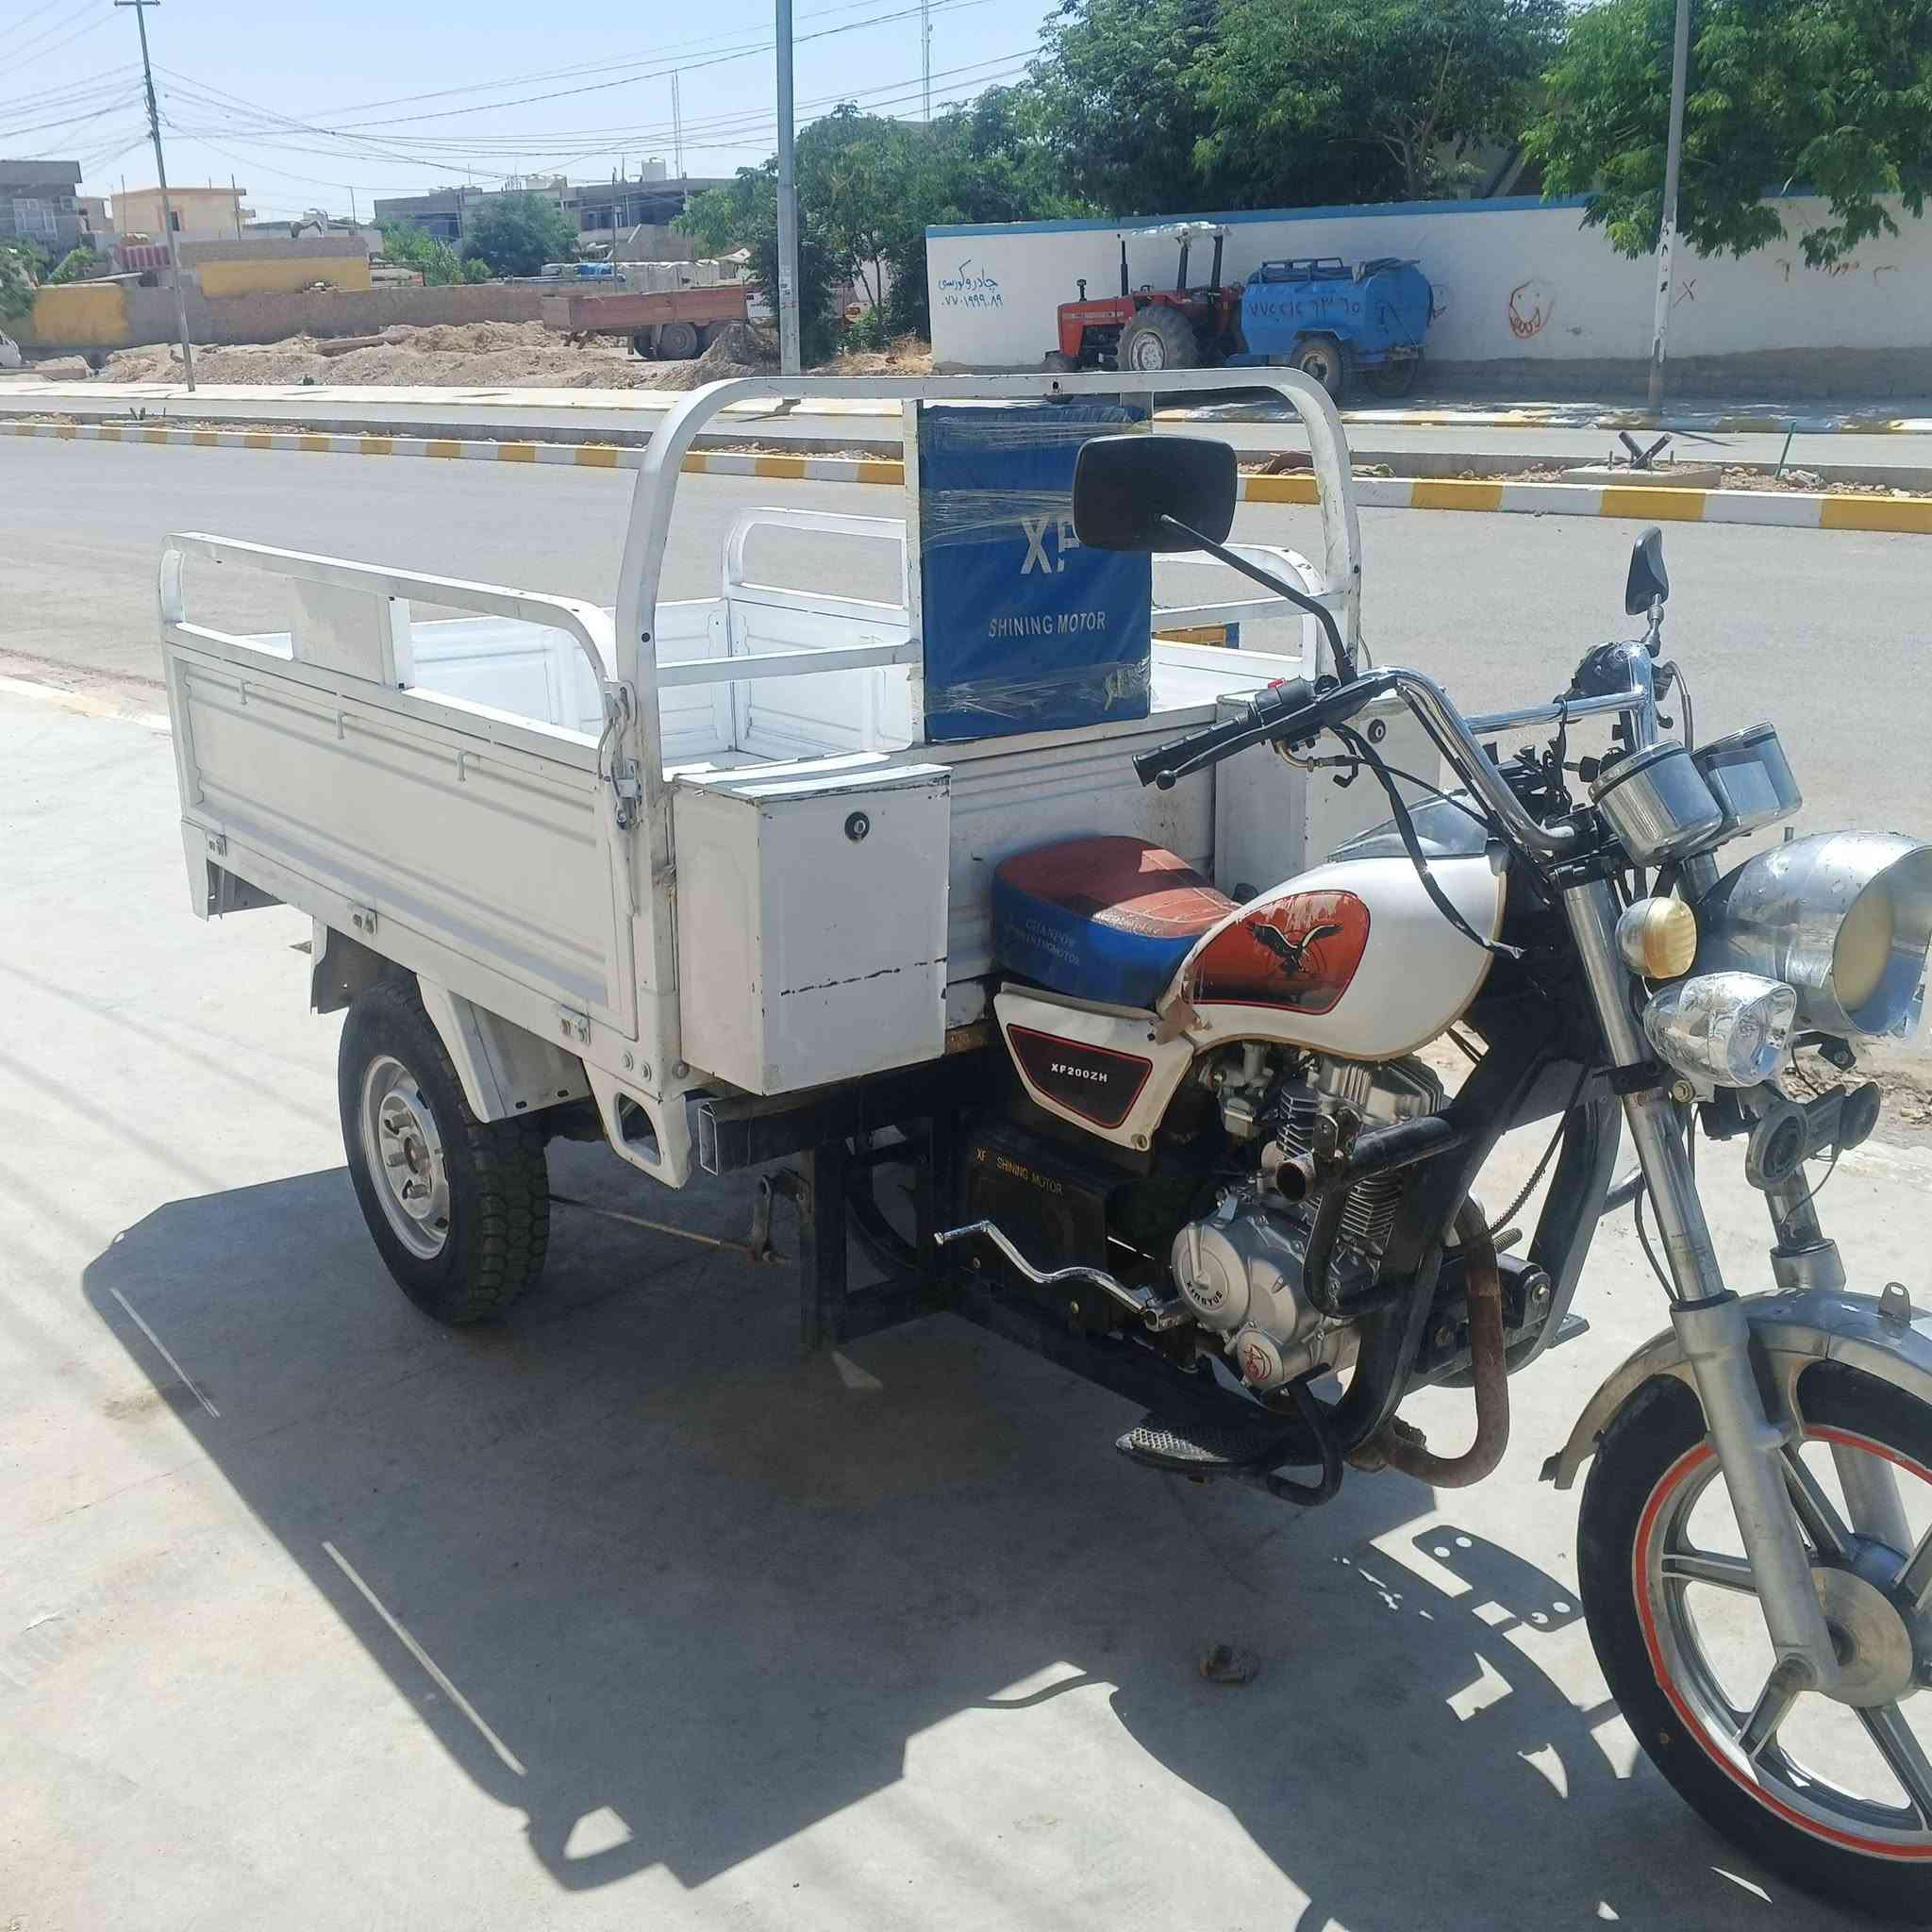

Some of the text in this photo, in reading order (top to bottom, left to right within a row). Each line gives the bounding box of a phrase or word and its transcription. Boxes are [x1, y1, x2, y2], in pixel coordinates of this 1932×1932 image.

[989, 611, 1107, 638] SHINING MOTOR
[1051, 1063, 1108, 1083] XF200ZH
[976, 1147, 988, 1161] XF
[1031, 1172, 1064, 1196] MOTOR
